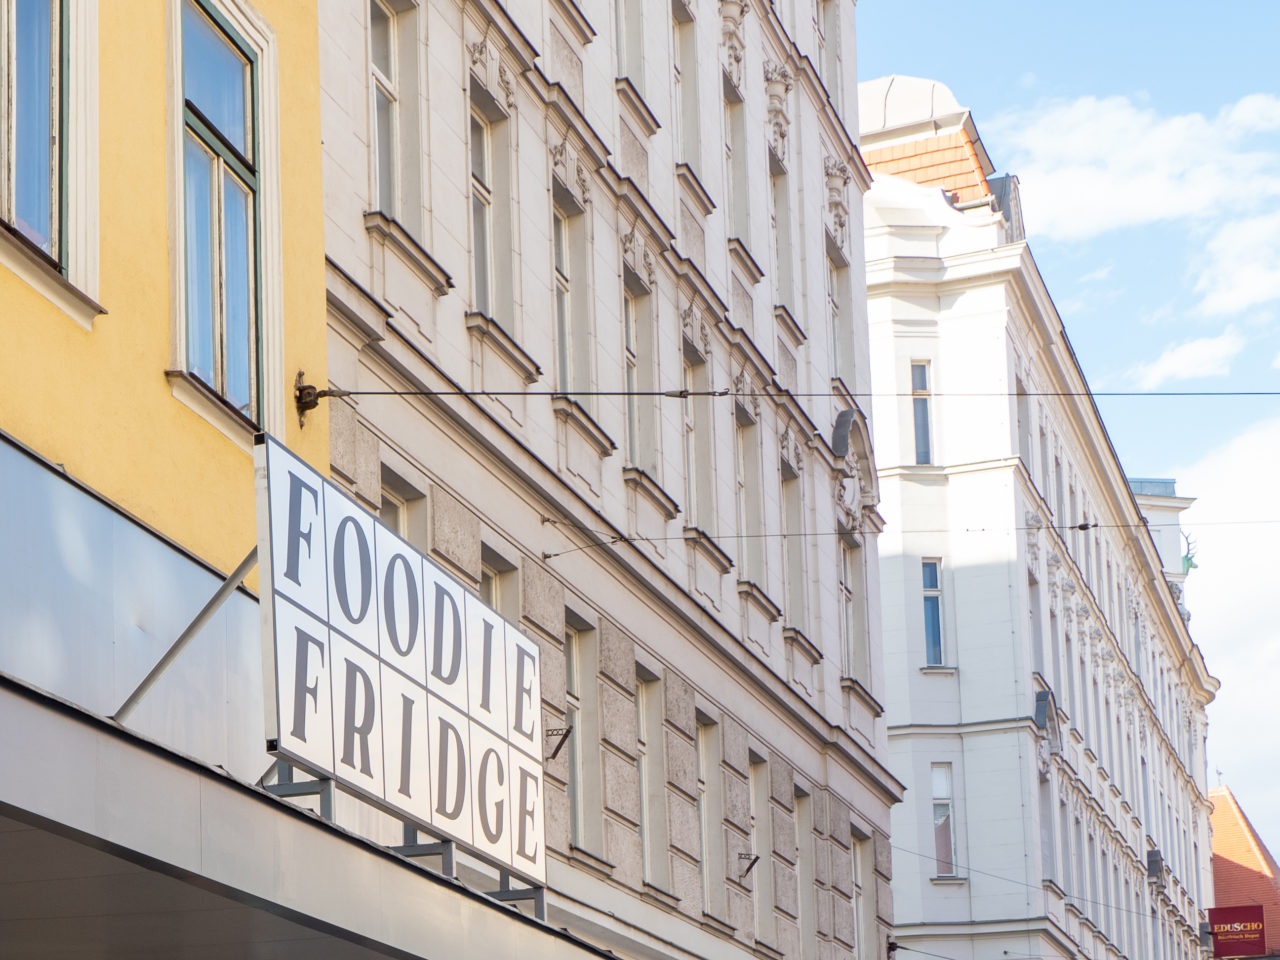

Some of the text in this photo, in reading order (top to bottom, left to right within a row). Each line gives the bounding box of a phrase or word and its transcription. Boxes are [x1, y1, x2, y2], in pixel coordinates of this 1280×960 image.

[283, 470, 536, 742] FOODIE
[290, 626, 539, 864] FRIDGE
[1214, 922, 1263, 932] EDUSCHO
